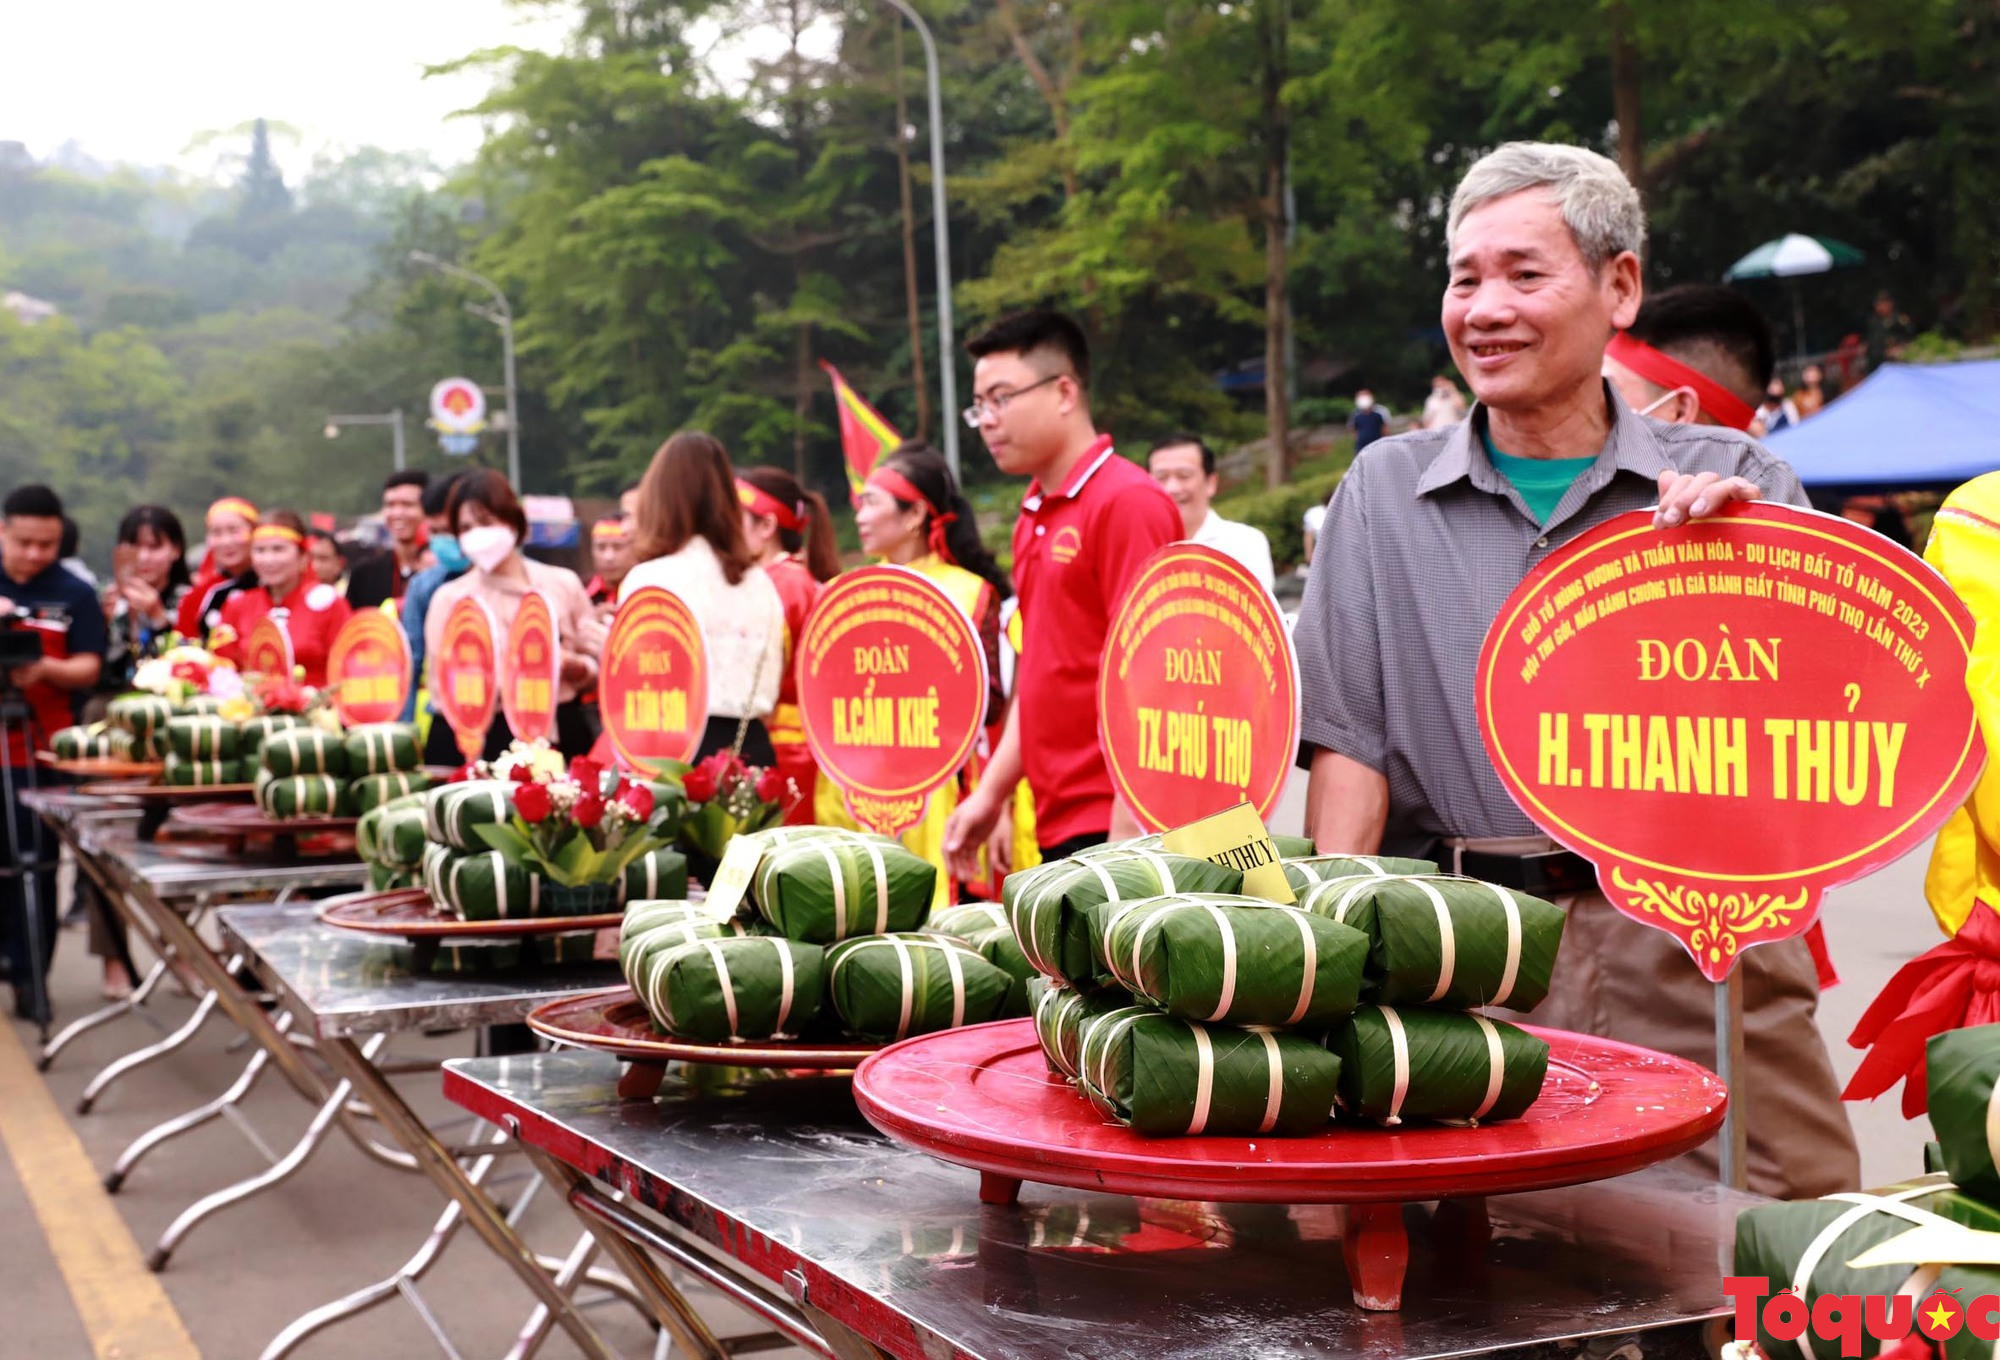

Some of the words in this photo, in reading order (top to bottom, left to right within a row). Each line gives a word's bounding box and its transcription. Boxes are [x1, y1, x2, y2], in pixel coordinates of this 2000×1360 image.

[1538, 595, 1555, 623] TỔ
[1623, 550, 1642, 574] VÀ
[1677, 539, 1704, 563] VĂN
[1706, 538, 1734, 561] HÓA
[1746, 543, 1765, 564] DU
[1769, 546, 1801, 571] LỊCH
[1803, 552, 1833, 580] ĐẤT
[1836, 562, 1857, 588] TỔ
[1856, 574, 1893, 610] NĂM
[1892, 599, 1930, 641] 2023
[854, 637, 909, 675] ĐOÀN
[1597, 592, 1628, 618] BÁNH
[1668, 573, 1685, 596] VÀ
[1708, 570, 1742, 595] BÁNH
[1776, 575, 1806, 607] TỈNH
[1808, 590, 1837, 616] PHÚ
[1839, 601, 1865, 634] THỌ
[1865, 616, 1895, 650] LẦN
[1894, 636, 1923, 673] THỨ
[1915, 667, 1931, 690] X
[1637, 624, 1782, 682] ĐOÀN
[1165, 638, 1222, 686] ĐOÀN
[898, 686, 940, 748] KHÊ
[1537, 712, 1748, 798] H.THANH
[1764, 682, 1907, 808] THỦY
[1137, 701, 1208, 780] TX.PHÚ
[1212, 716, 1252, 802] THỌ
[1228, 835, 1275, 871] THỦY
